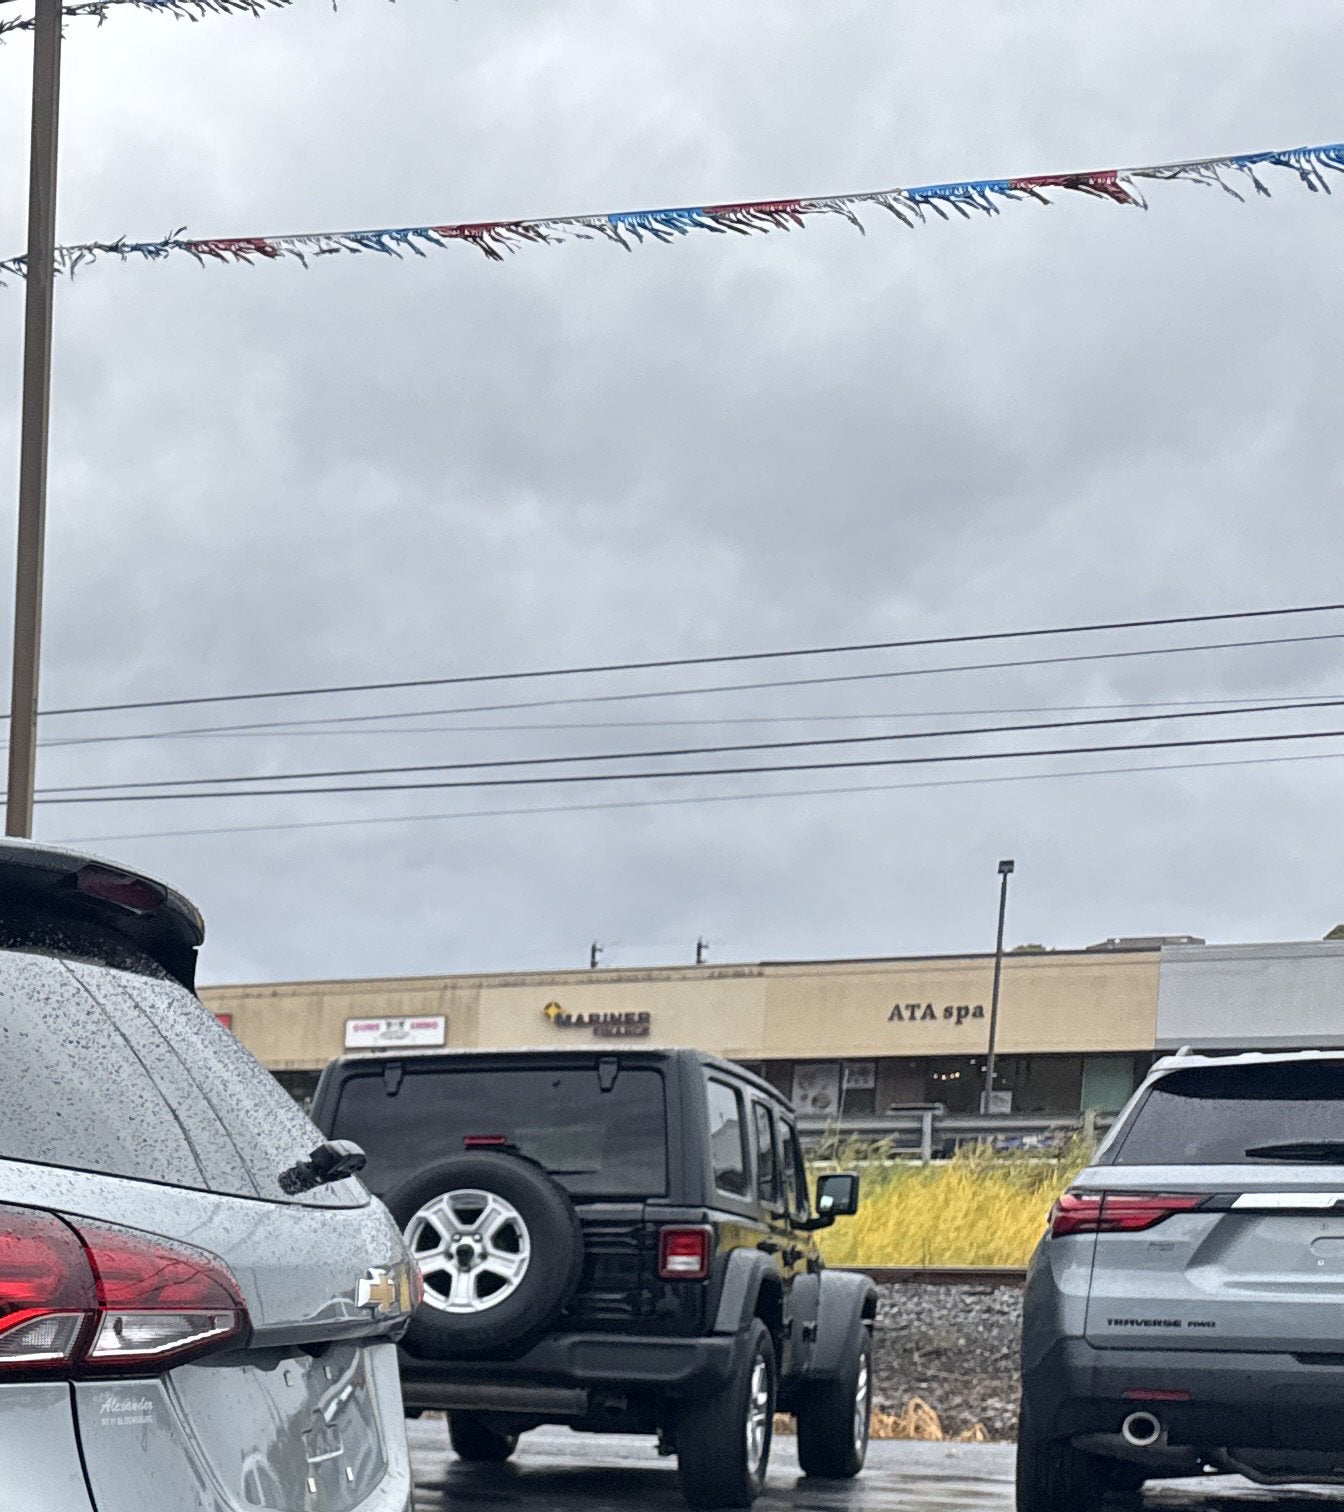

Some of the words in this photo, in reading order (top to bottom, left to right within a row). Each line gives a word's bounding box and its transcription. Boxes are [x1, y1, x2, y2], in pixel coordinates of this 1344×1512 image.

[554, 1011, 651, 1029] MARINER
[887, 1003, 938, 1021] ATA
[942, 1003, 985, 1025] spa
[1107, 1318, 1182, 1328] TRAVERSE
